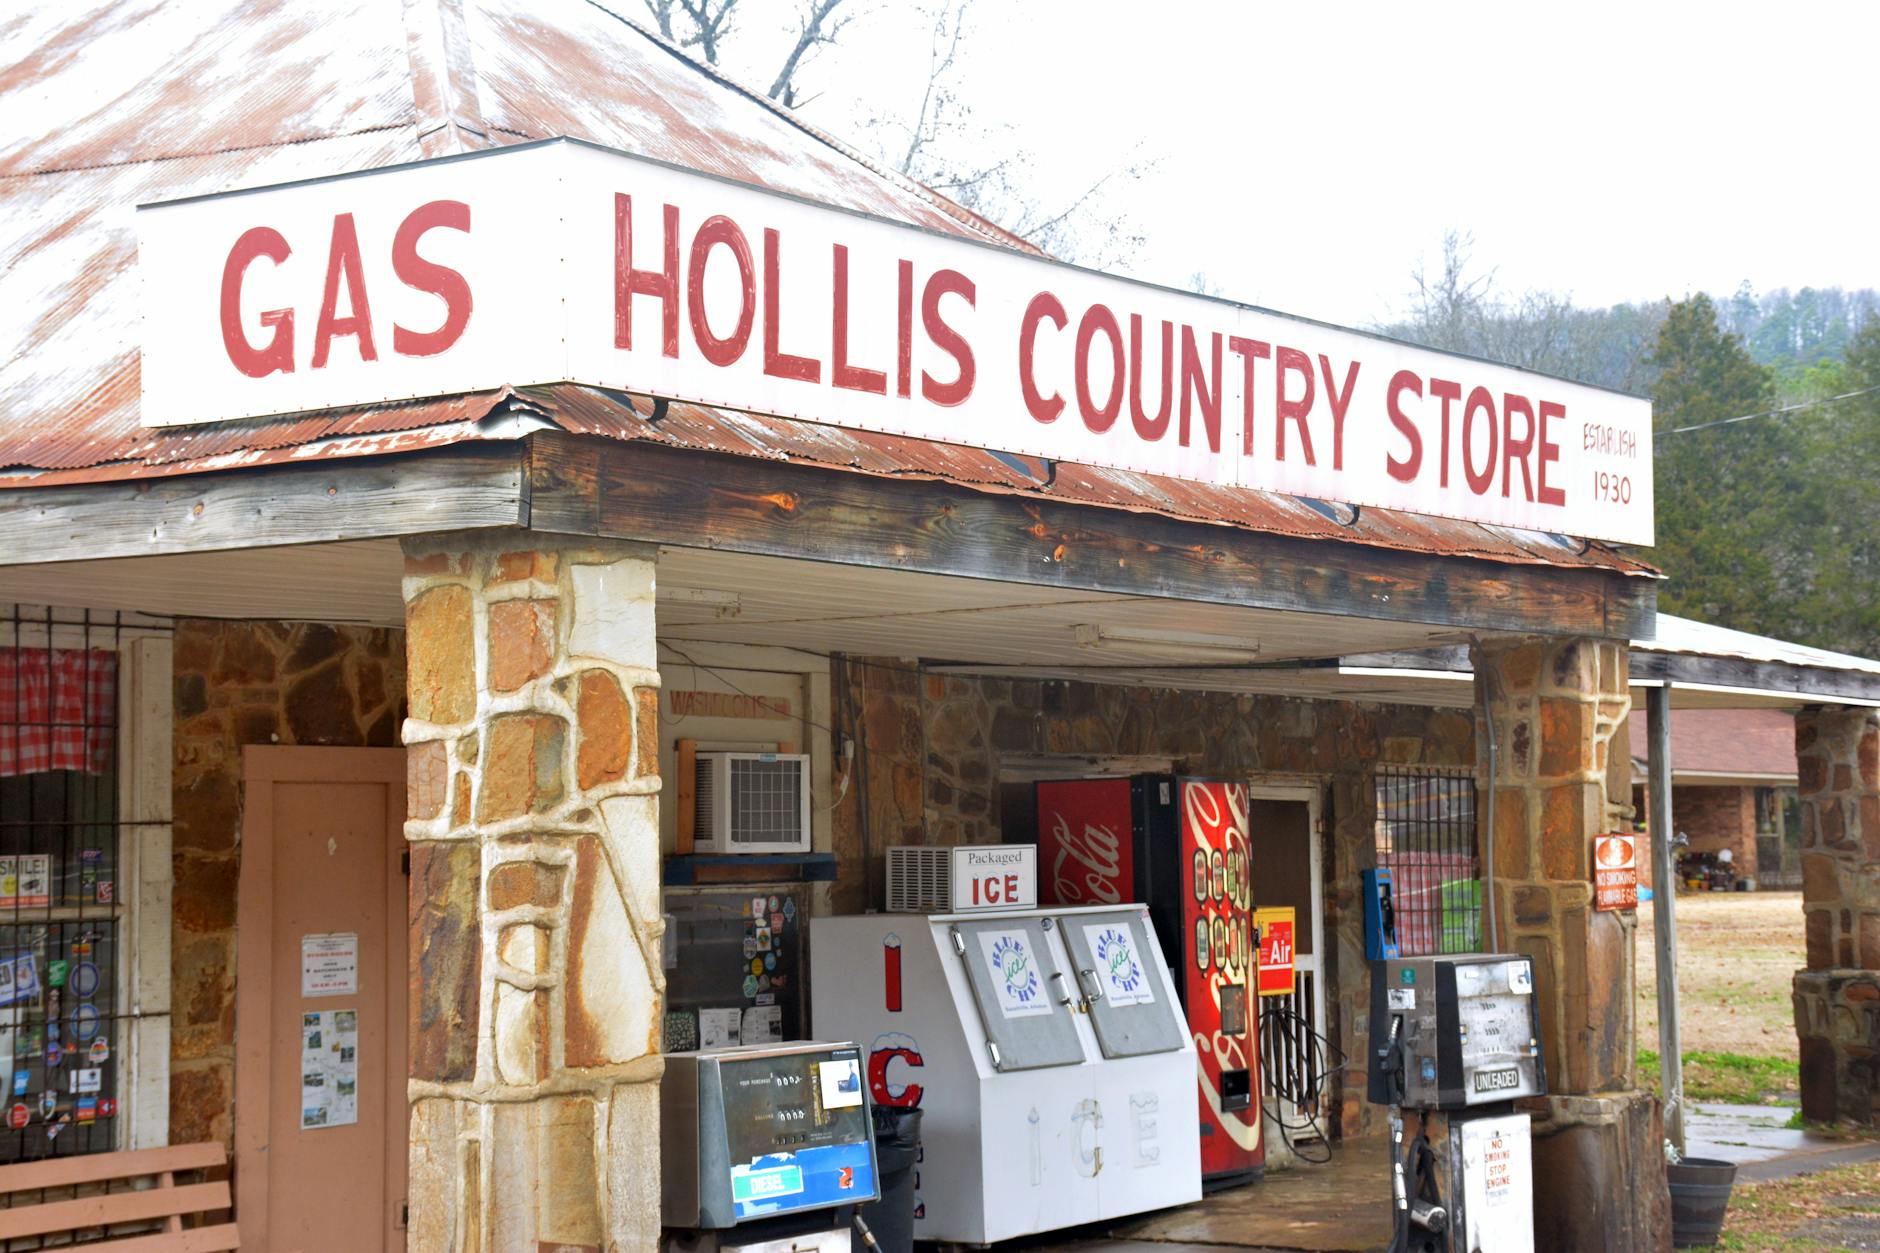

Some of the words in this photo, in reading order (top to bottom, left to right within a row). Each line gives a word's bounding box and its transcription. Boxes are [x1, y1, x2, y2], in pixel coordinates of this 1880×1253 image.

[219, 199, 474, 379] GAS
[614, 191, 977, 408] HOLLIS
[1018, 290, 1361, 471] COUNTRY
[1385, 369, 1566, 508] STORE
[1594, 471, 1632, 504] 1930
[968, 850, 1022, 866] Packaged
[972, 873, 1019, 906] ICE
[1596, 871, 1607, 886] NO
[1607, 870, 1636, 885] SMOKING
[993, 936, 1025, 969] BLUE
[1097, 929, 1127, 960] BLUE
[1270, 939, 1291, 965] Air
[1006, 956, 1028, 983] ice
[1110, 949, 1130, 974] ice
[1006, 970, 1037, 1002] CHIP
[1111, 962, 1140, 992] CHIP
[1475, 1069, 1518, 1091] UNLEADED
[1485, 1149, 1510, 1164] SMOKING
[1491, 1138, 1503, 1150] NO
[1487, 1175, 1511, 1190] ENGINE
[1490, 1164, 1507, 1176] STOP
[751, 1174, 785, 1195] DIESEL
